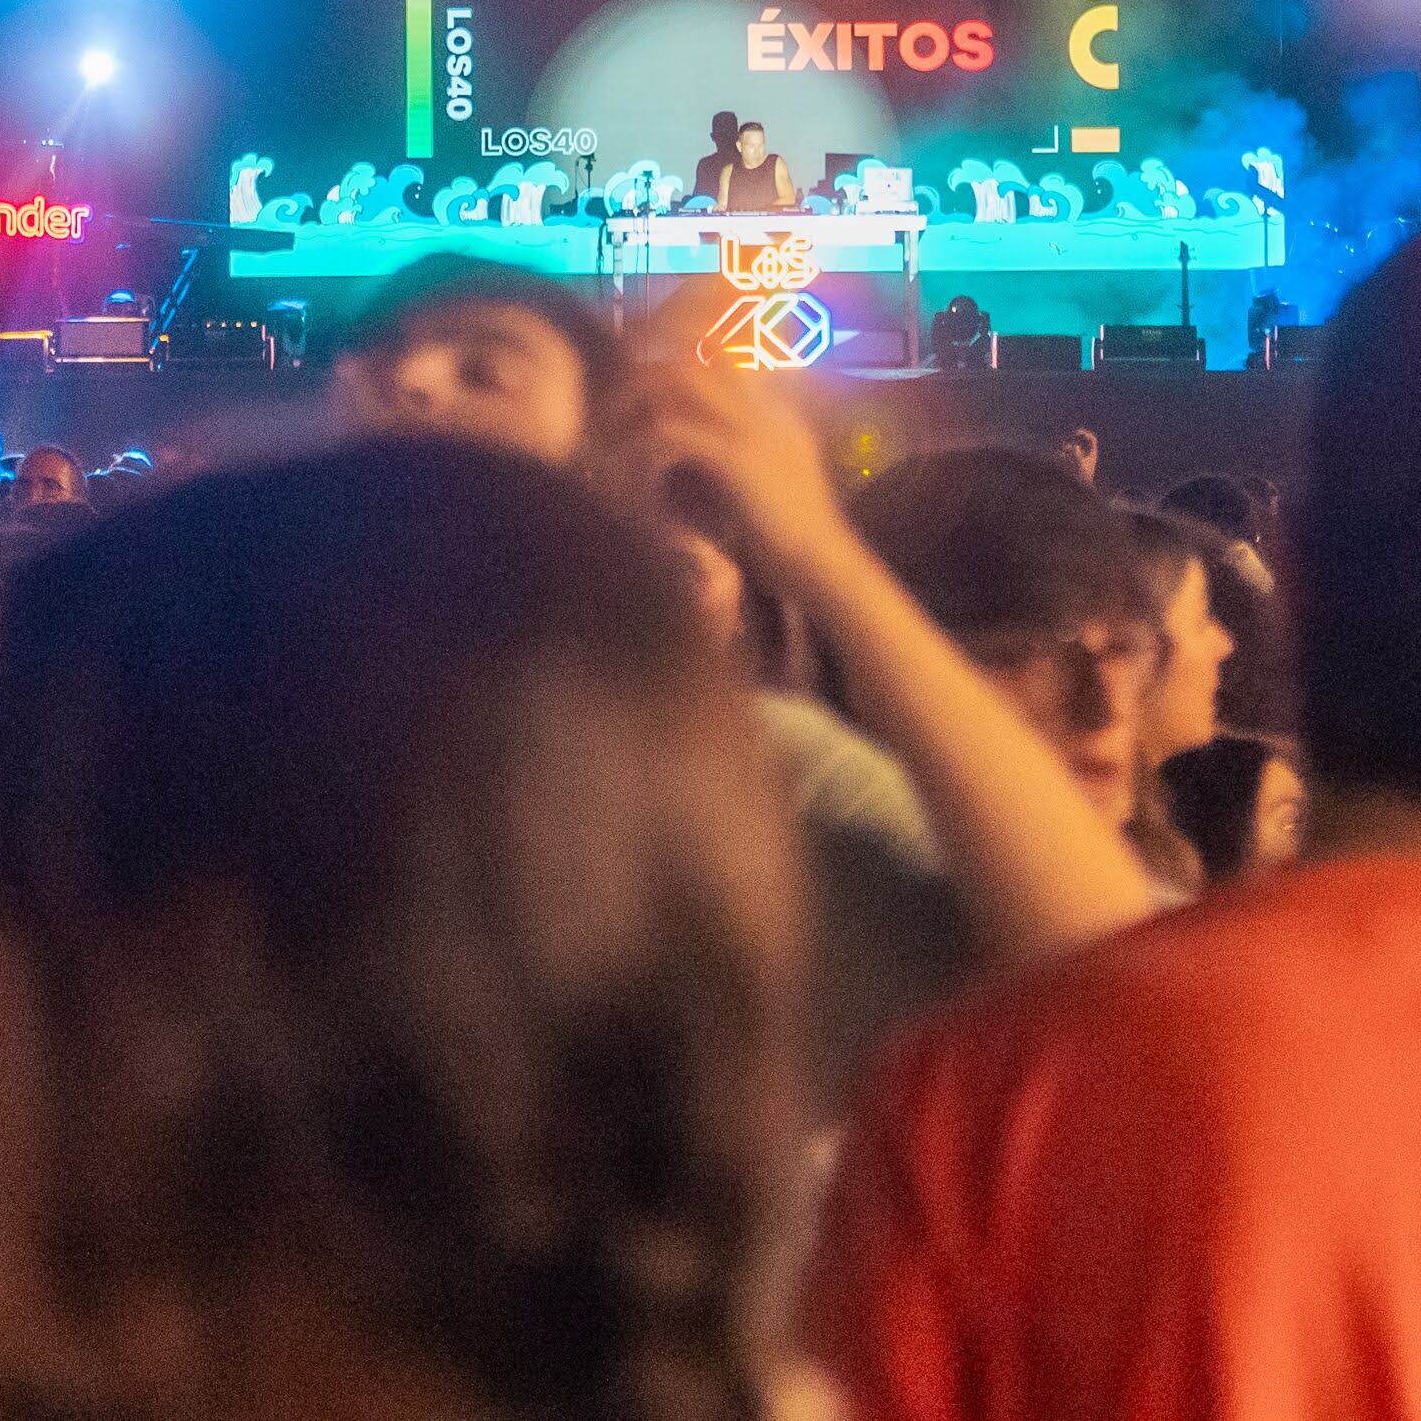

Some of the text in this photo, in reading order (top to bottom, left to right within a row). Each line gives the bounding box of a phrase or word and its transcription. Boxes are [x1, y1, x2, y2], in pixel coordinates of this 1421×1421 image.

[445, 6, 474, 122] LOS40
[746, 8, 995, 72] ÉXITOS
[480, 127, 598, 157] LOS40
